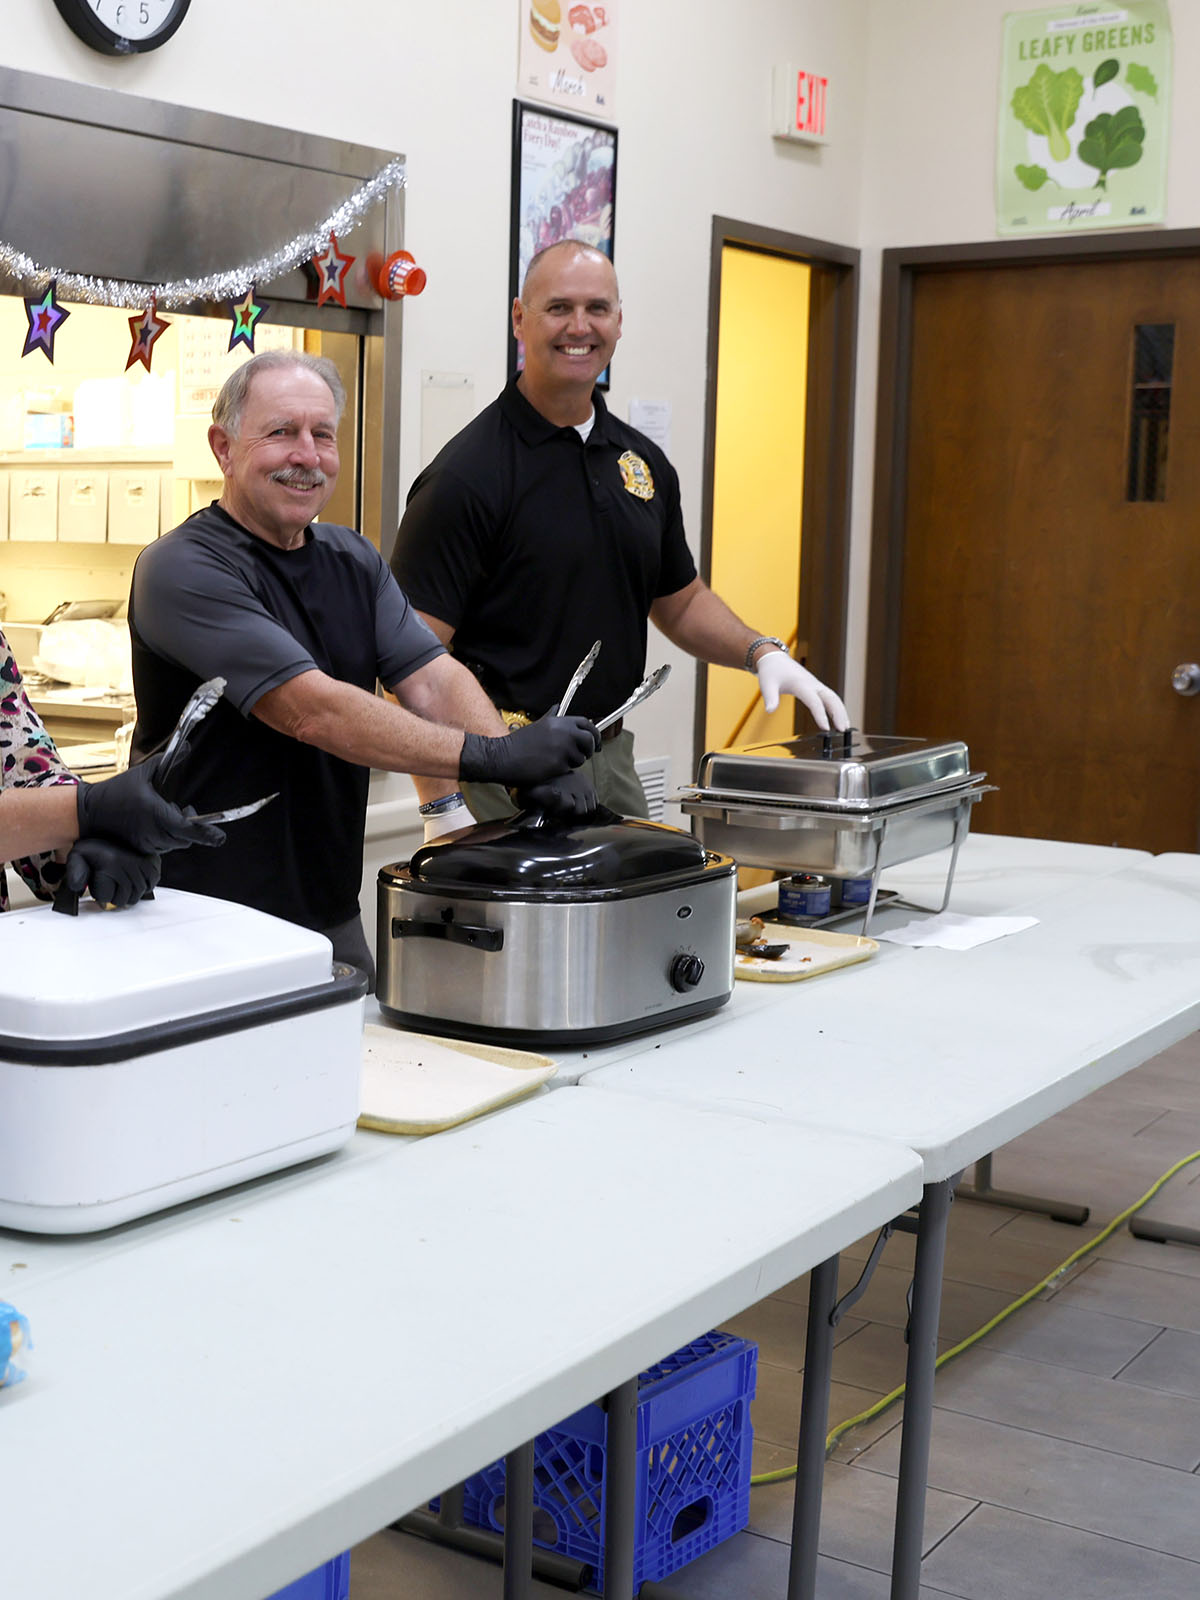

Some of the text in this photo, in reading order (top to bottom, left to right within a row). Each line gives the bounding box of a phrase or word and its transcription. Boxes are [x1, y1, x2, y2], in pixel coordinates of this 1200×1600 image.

[140, 2, 150, 24] 5
[1019, 23, 1155, 61] LEAFY GREENS
[796, 70, 828, 136] EXIT
